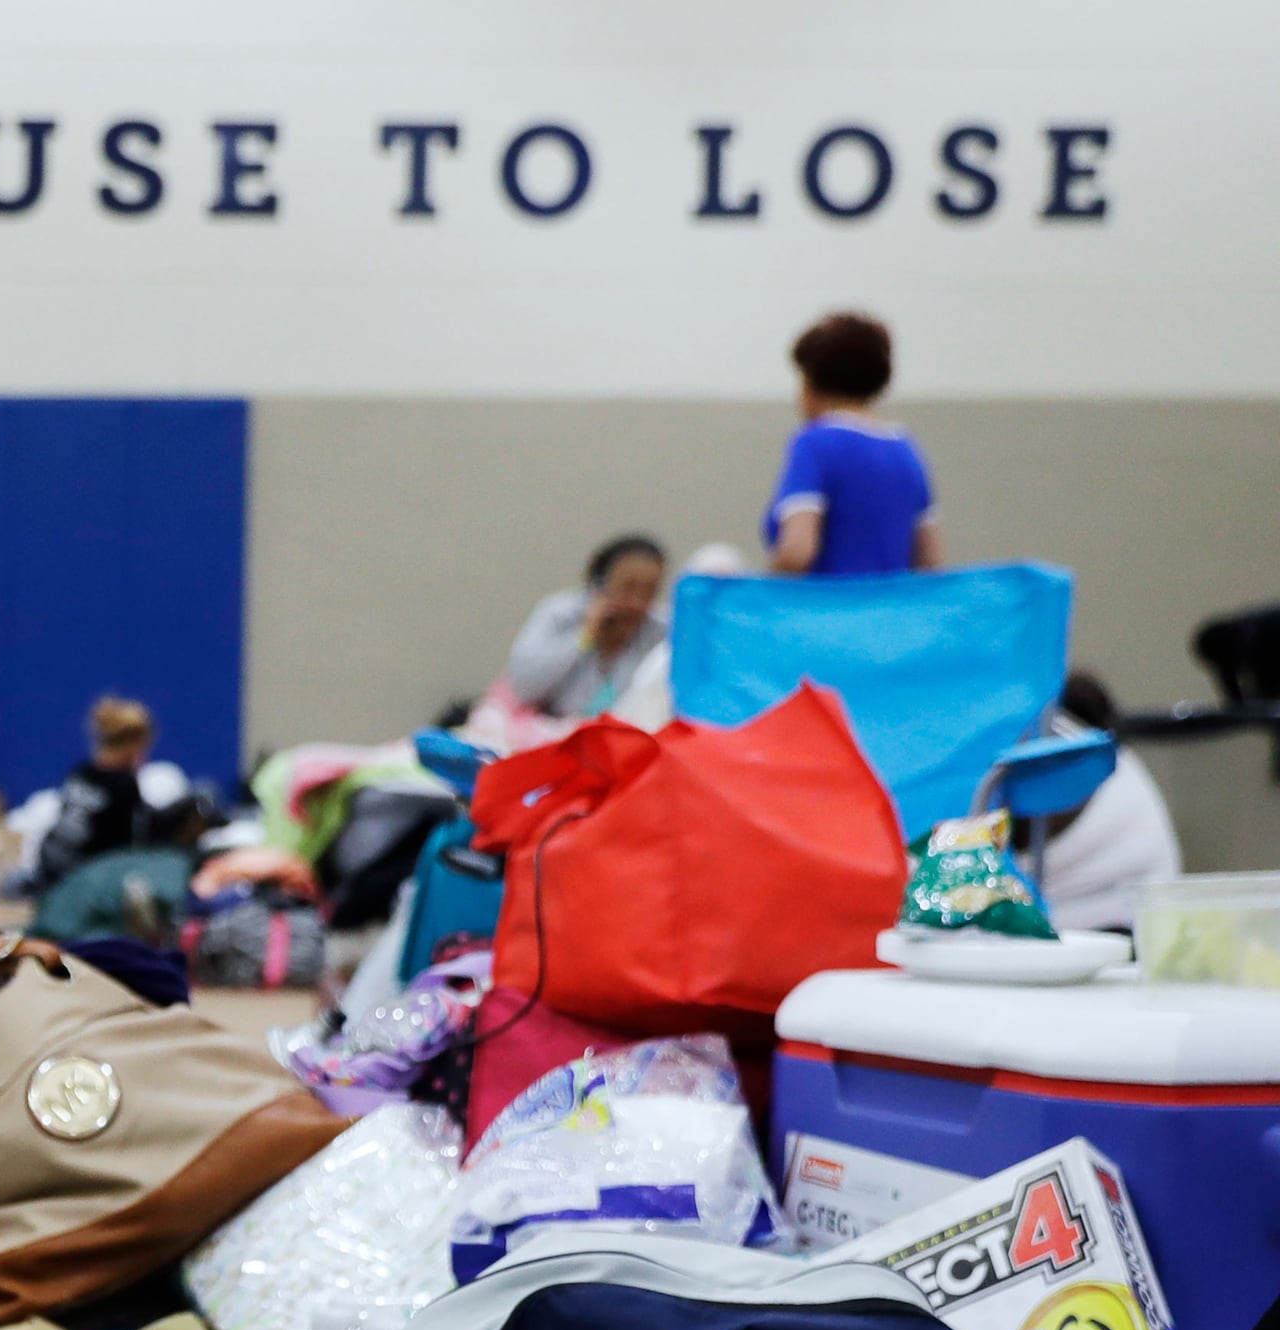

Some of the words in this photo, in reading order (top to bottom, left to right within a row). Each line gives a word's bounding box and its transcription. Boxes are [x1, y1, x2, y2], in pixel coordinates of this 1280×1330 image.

[377, 121, 595, 223] TO
[692, 122, 1114, 226] LOSE
[1009, 1177, 1081, 1270] 4
